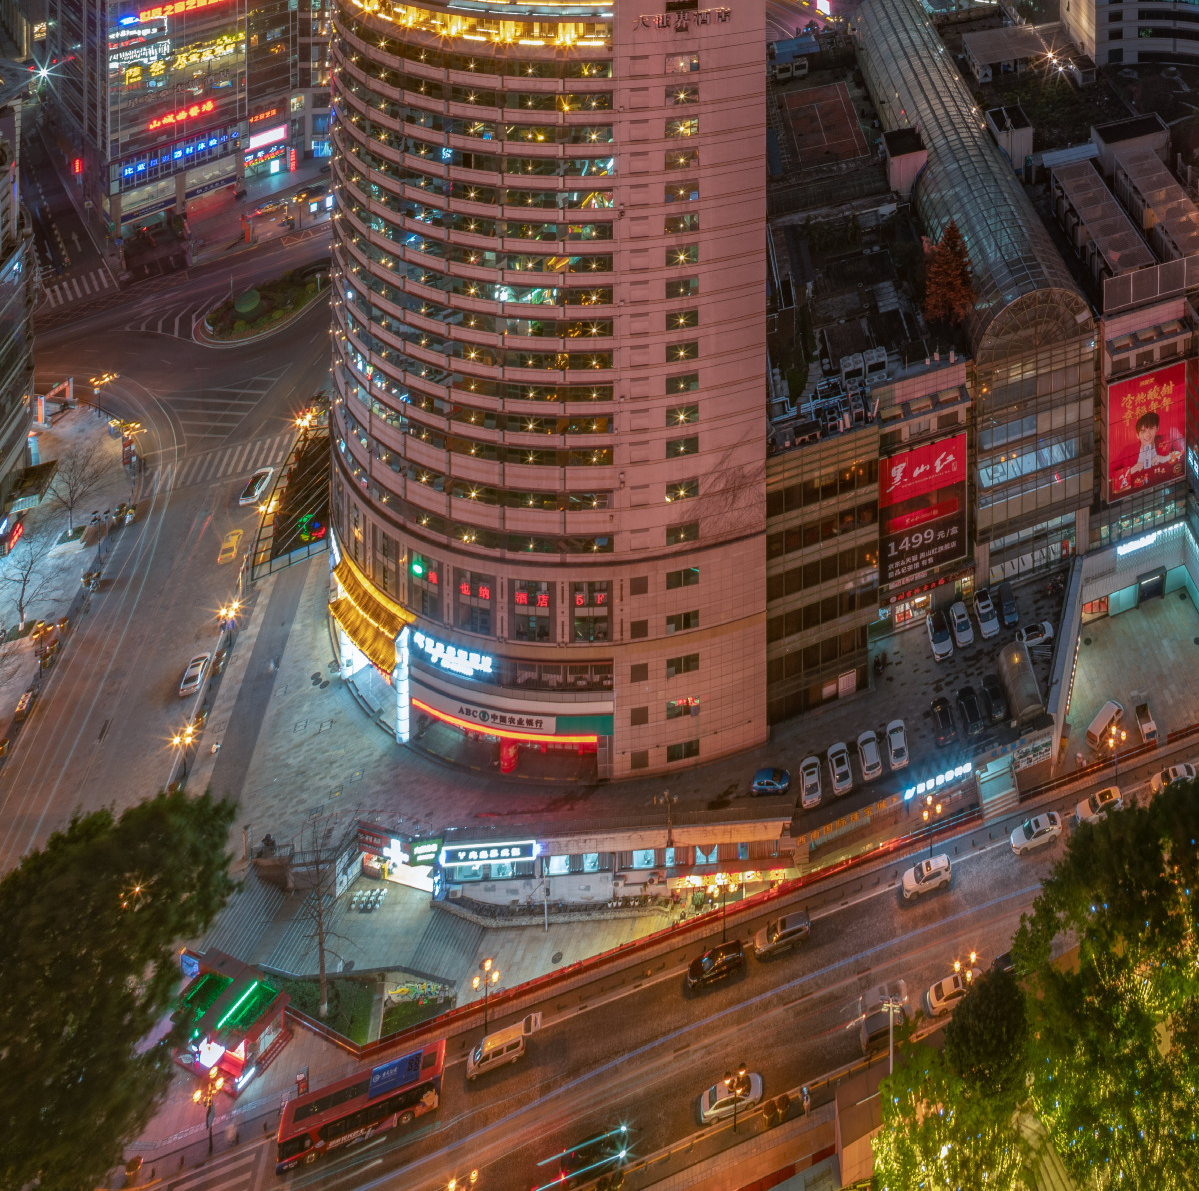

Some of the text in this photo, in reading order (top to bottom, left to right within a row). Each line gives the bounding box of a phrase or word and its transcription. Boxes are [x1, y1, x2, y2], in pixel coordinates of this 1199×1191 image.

[633, 10, 731, 31] 大世界酒店
[1121, 381, 1175, 409] 冷热酸甜
[886, 451, 956, 493] 黑山红
[888, 526, 959, 558] 1499 元/盒
[428, 570, 549, 607] 维也纳酒店
[458, 706, 544, 728] ABC 中国农业银行
[797, 799, 887, 846] 西南国际珠宝城
